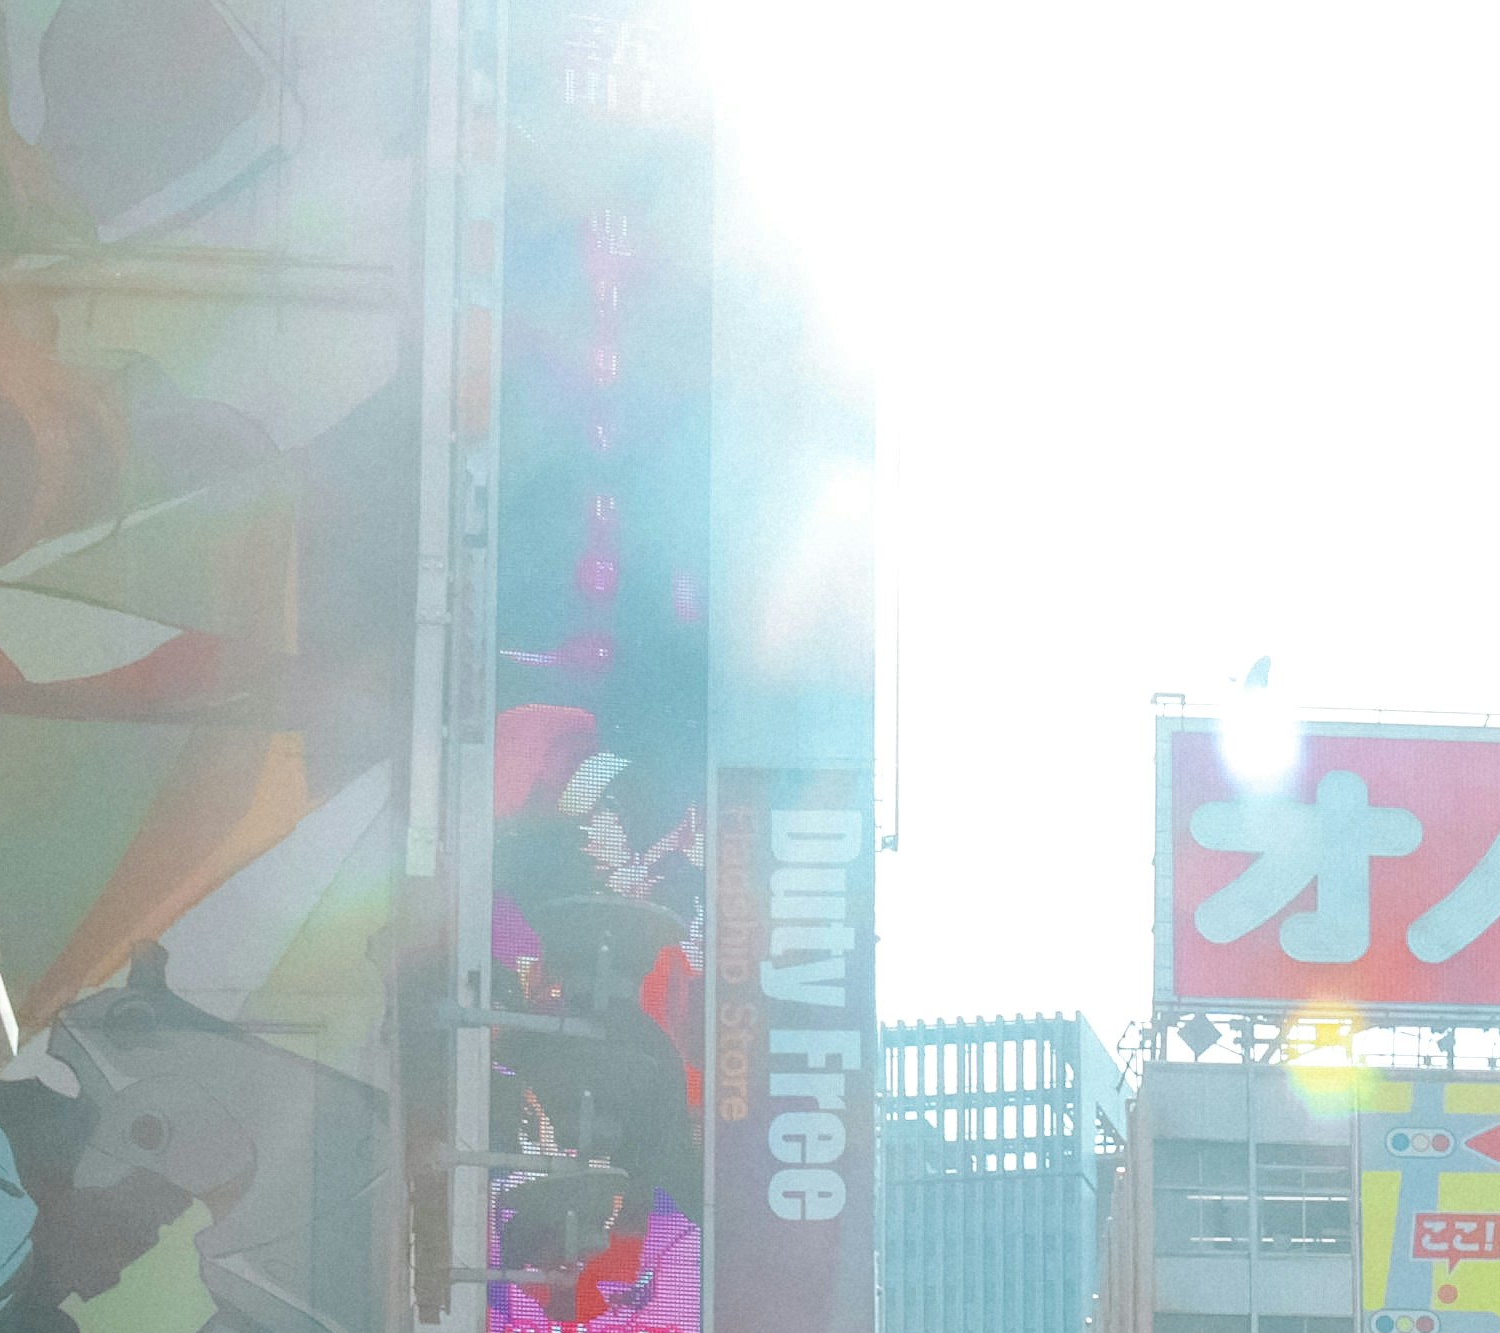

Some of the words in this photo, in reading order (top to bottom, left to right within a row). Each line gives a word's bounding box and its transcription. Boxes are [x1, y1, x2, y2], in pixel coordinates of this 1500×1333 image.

[760, 809, 862, 1008] Duty
[719, 1001, 756, 1122] Store
[767, 1029, 861, 1221] Free
[1420, 1218, 1496, 1253] ここ!
